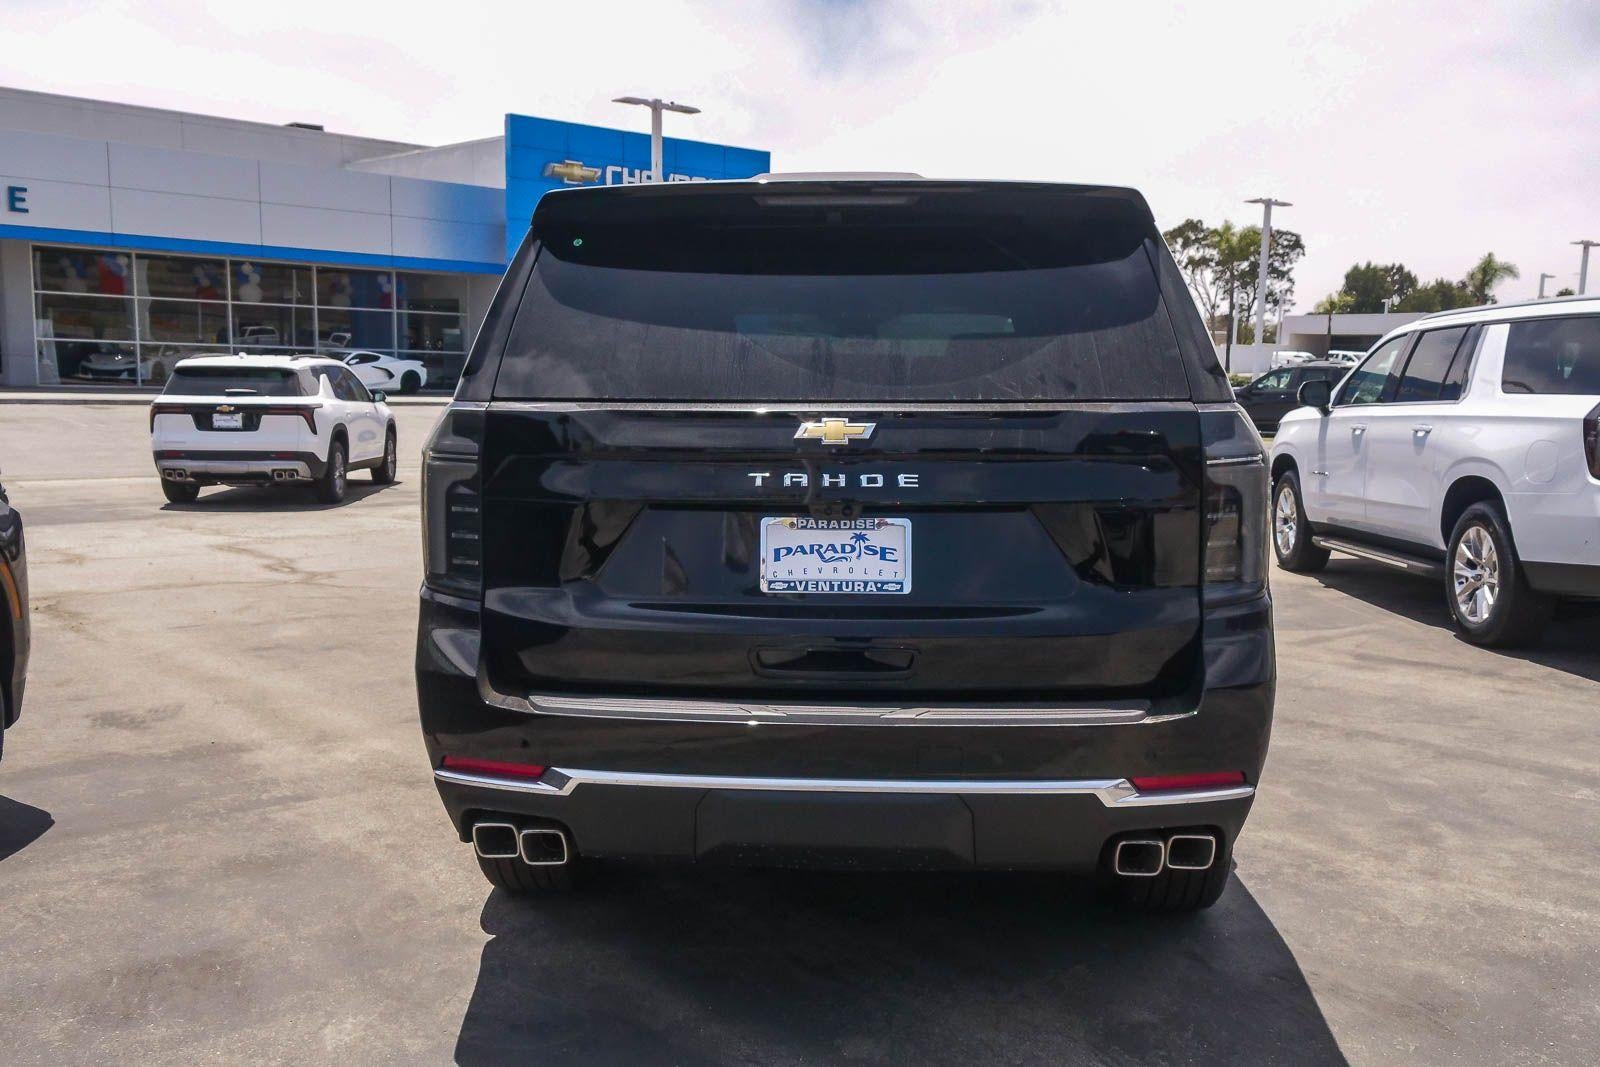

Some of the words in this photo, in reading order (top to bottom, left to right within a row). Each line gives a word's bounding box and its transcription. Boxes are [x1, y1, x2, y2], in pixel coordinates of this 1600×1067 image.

[748, 472, 919, 487] TAHOE
[798, 519, 875, 529] PARADISE
[774, 534, 898, 563] PARADISE
[773, 566, 898, 578] CHEVROLET
[795, 581, 877, 592] VENTURA
